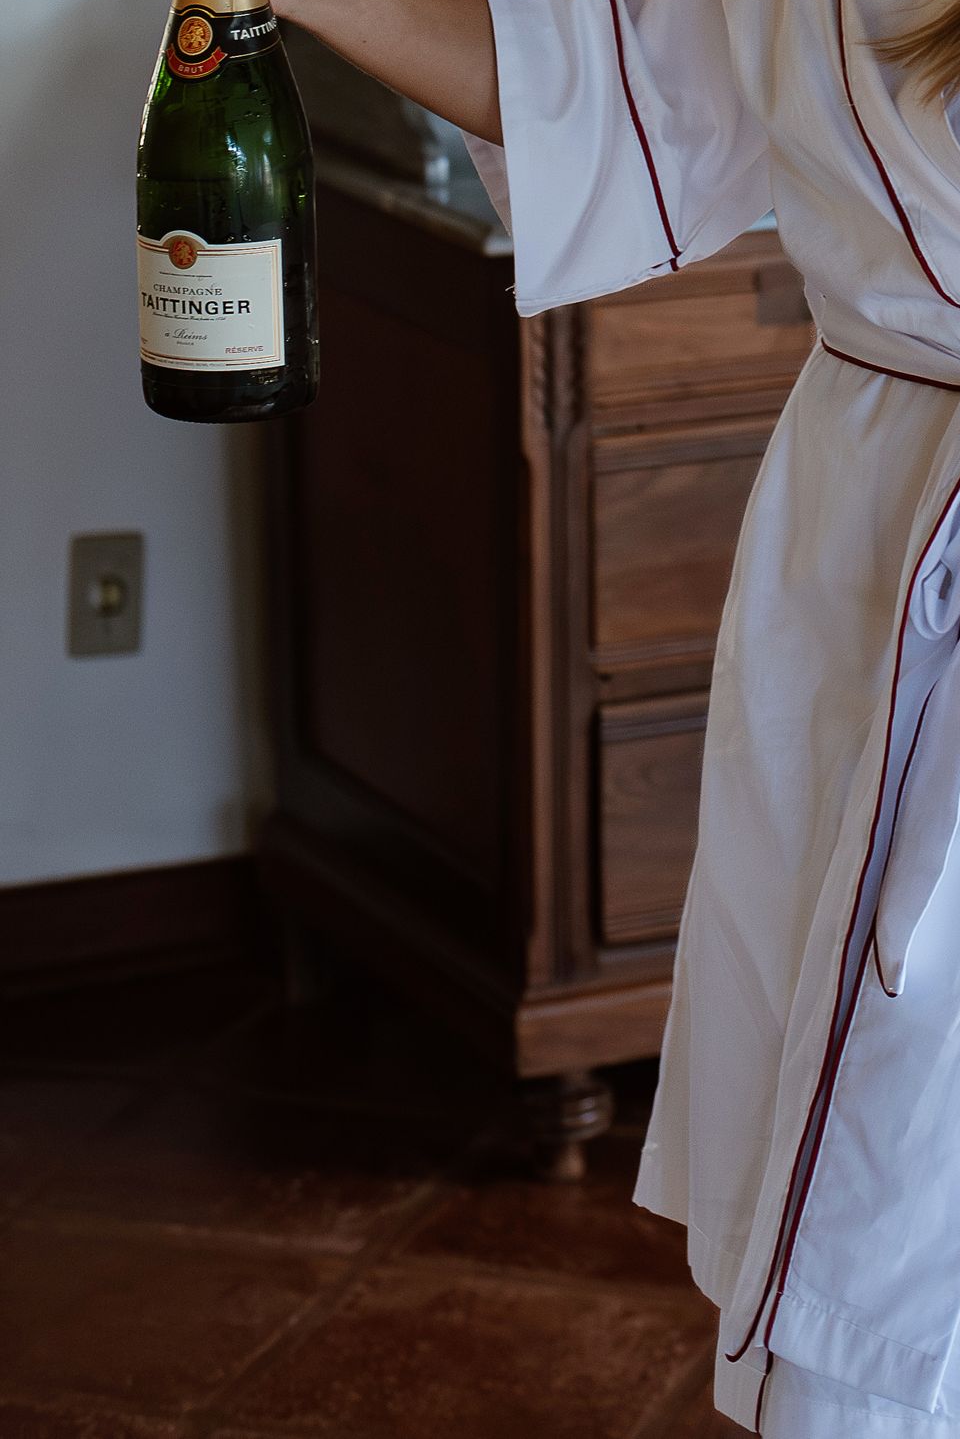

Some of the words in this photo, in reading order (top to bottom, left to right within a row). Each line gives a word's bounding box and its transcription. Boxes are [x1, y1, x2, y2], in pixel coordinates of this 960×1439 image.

[177, 64, 204, 74] BRUT
[153, 283, 223, 296] CHAMPAGNE
[141, 292, 251, 315] TAITTINGER
[172, 328, 208, 341] Reims
[225, 345, 264, 354] RÉSERVE
